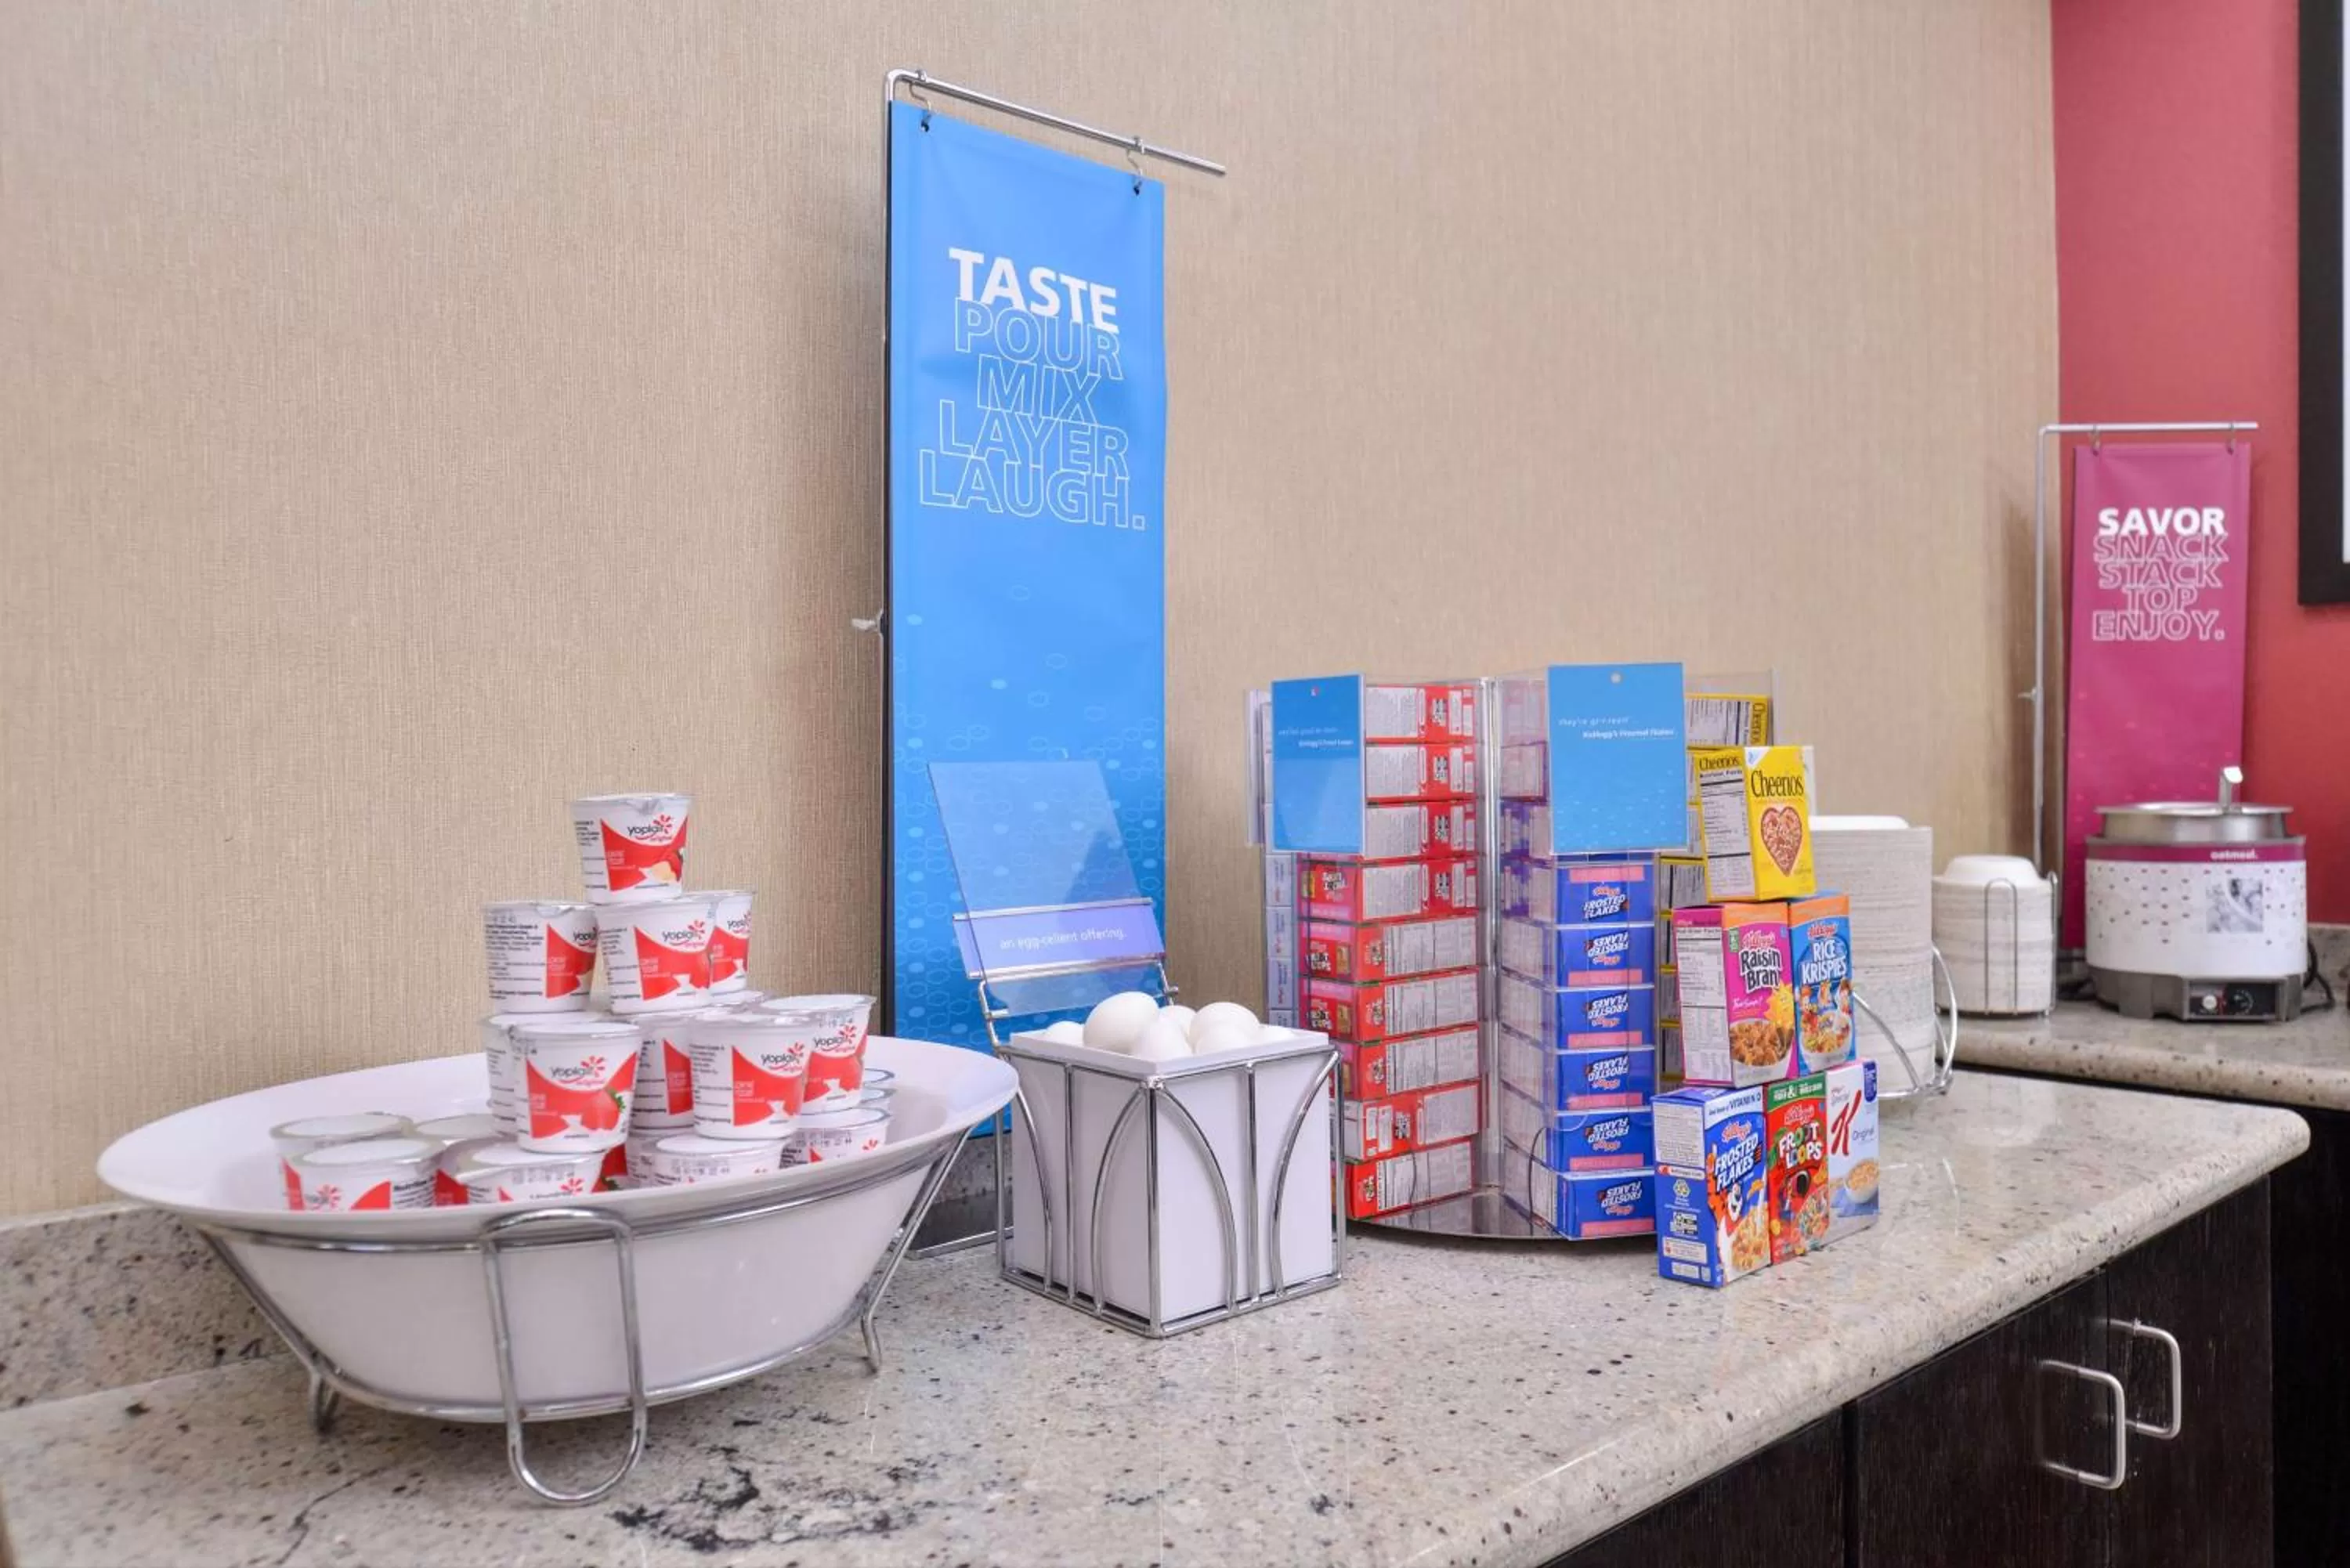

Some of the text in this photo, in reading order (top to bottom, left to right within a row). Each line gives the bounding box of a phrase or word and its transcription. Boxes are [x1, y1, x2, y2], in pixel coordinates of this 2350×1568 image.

[949, 247, 1119, 334] TASTE
[955, 298, 1123, 380] POUR
[978, 355, 1101, 425] MIX
[940, 399, 1130, 479] LAYER
[920, 450, 1145, 530] LAUGH.
[2099, 508, 2225, 536] SAVOR
[2093, 534, 2229, 562] SNACK
[2099, 560, 2223, 588] STACK
[2122, 584, 2197, 612] TOP
[2092, 610, 2225, 641] ENJOY.
[1751, 771, 1805, 797] Cheerios
[1584, 894, 1626, 911] FROSTED
[1585, 905, 1621, 919] FLAKES
[1740, 948, 1781, 975] Raisin
[1813, 939, 1835, 963] RICE
[1746, 969, 1780, 993] Bran
[1801, 956, 1847, 985] KRISPIES
[1715, 1132, 1759, 1175] FROSTED
[1779, 1121, 1820, 1158] FROOT
[1786, 1140, 1823, 1169] LOOPS
[1716, 1155, 1754, 1192] FLAKES
